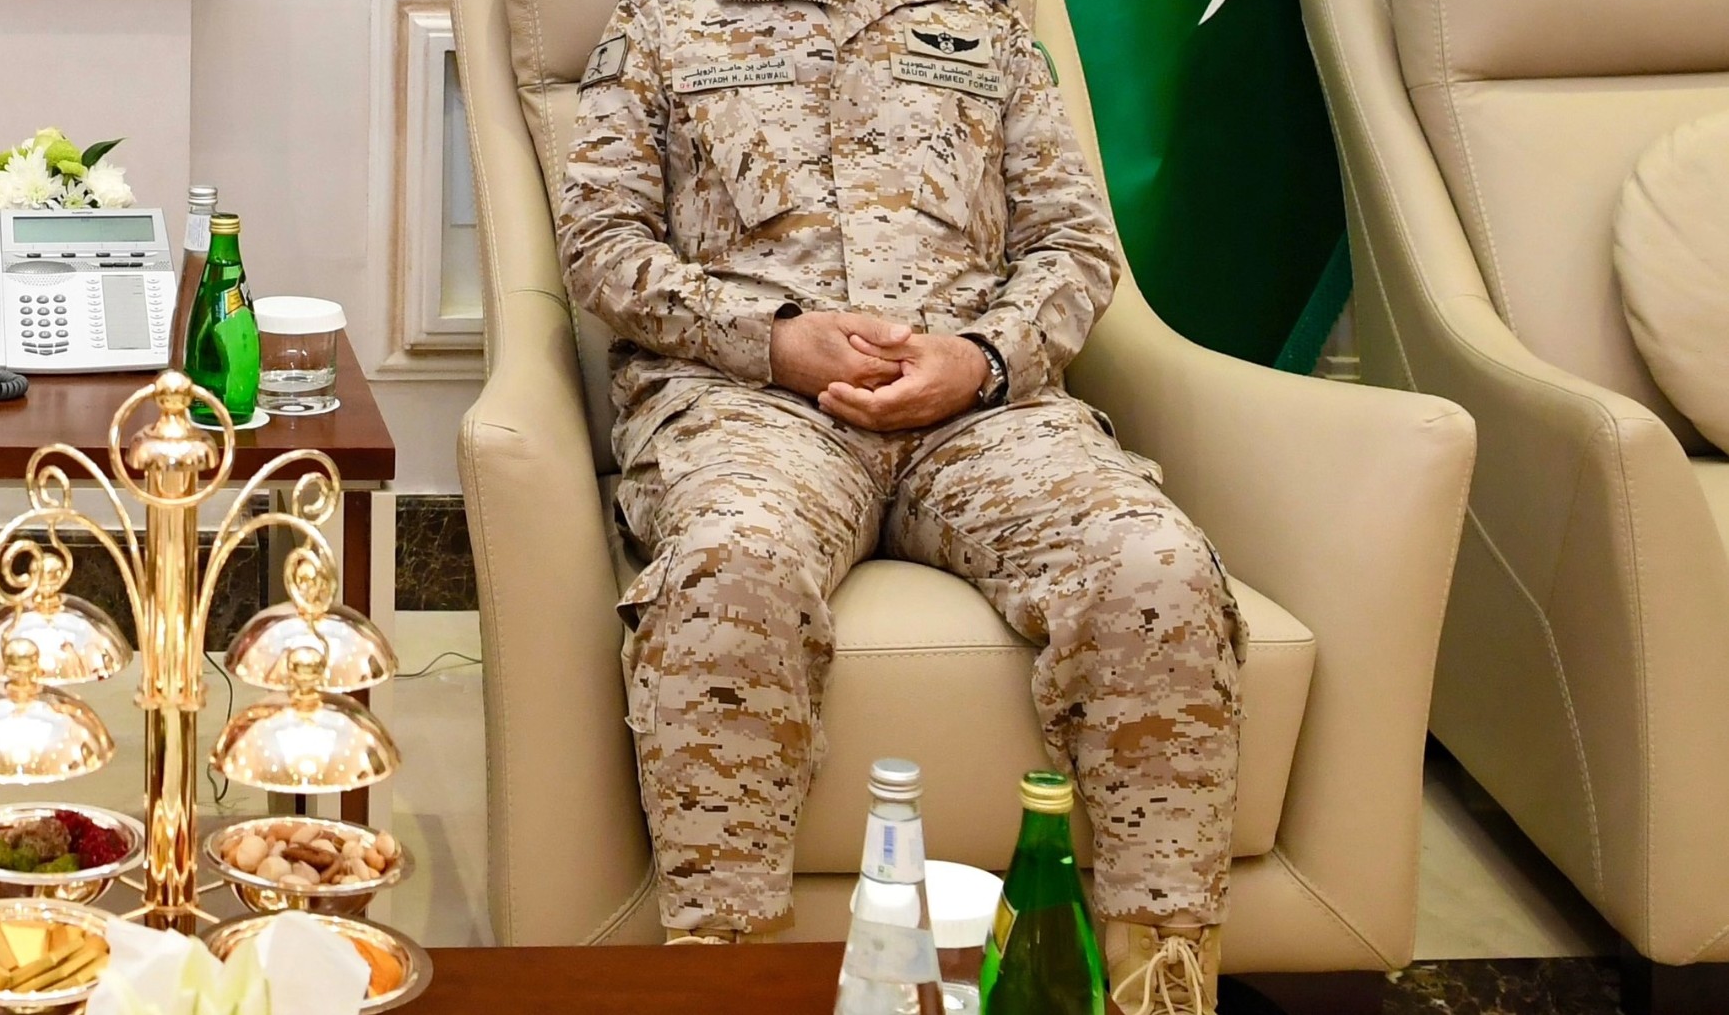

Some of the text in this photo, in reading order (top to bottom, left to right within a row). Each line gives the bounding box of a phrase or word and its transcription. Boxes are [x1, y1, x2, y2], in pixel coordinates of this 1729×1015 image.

[692, 76, 728, 87] FAYYADH
[901, 67, 999, 92] SAUDI ARMED FORCES
